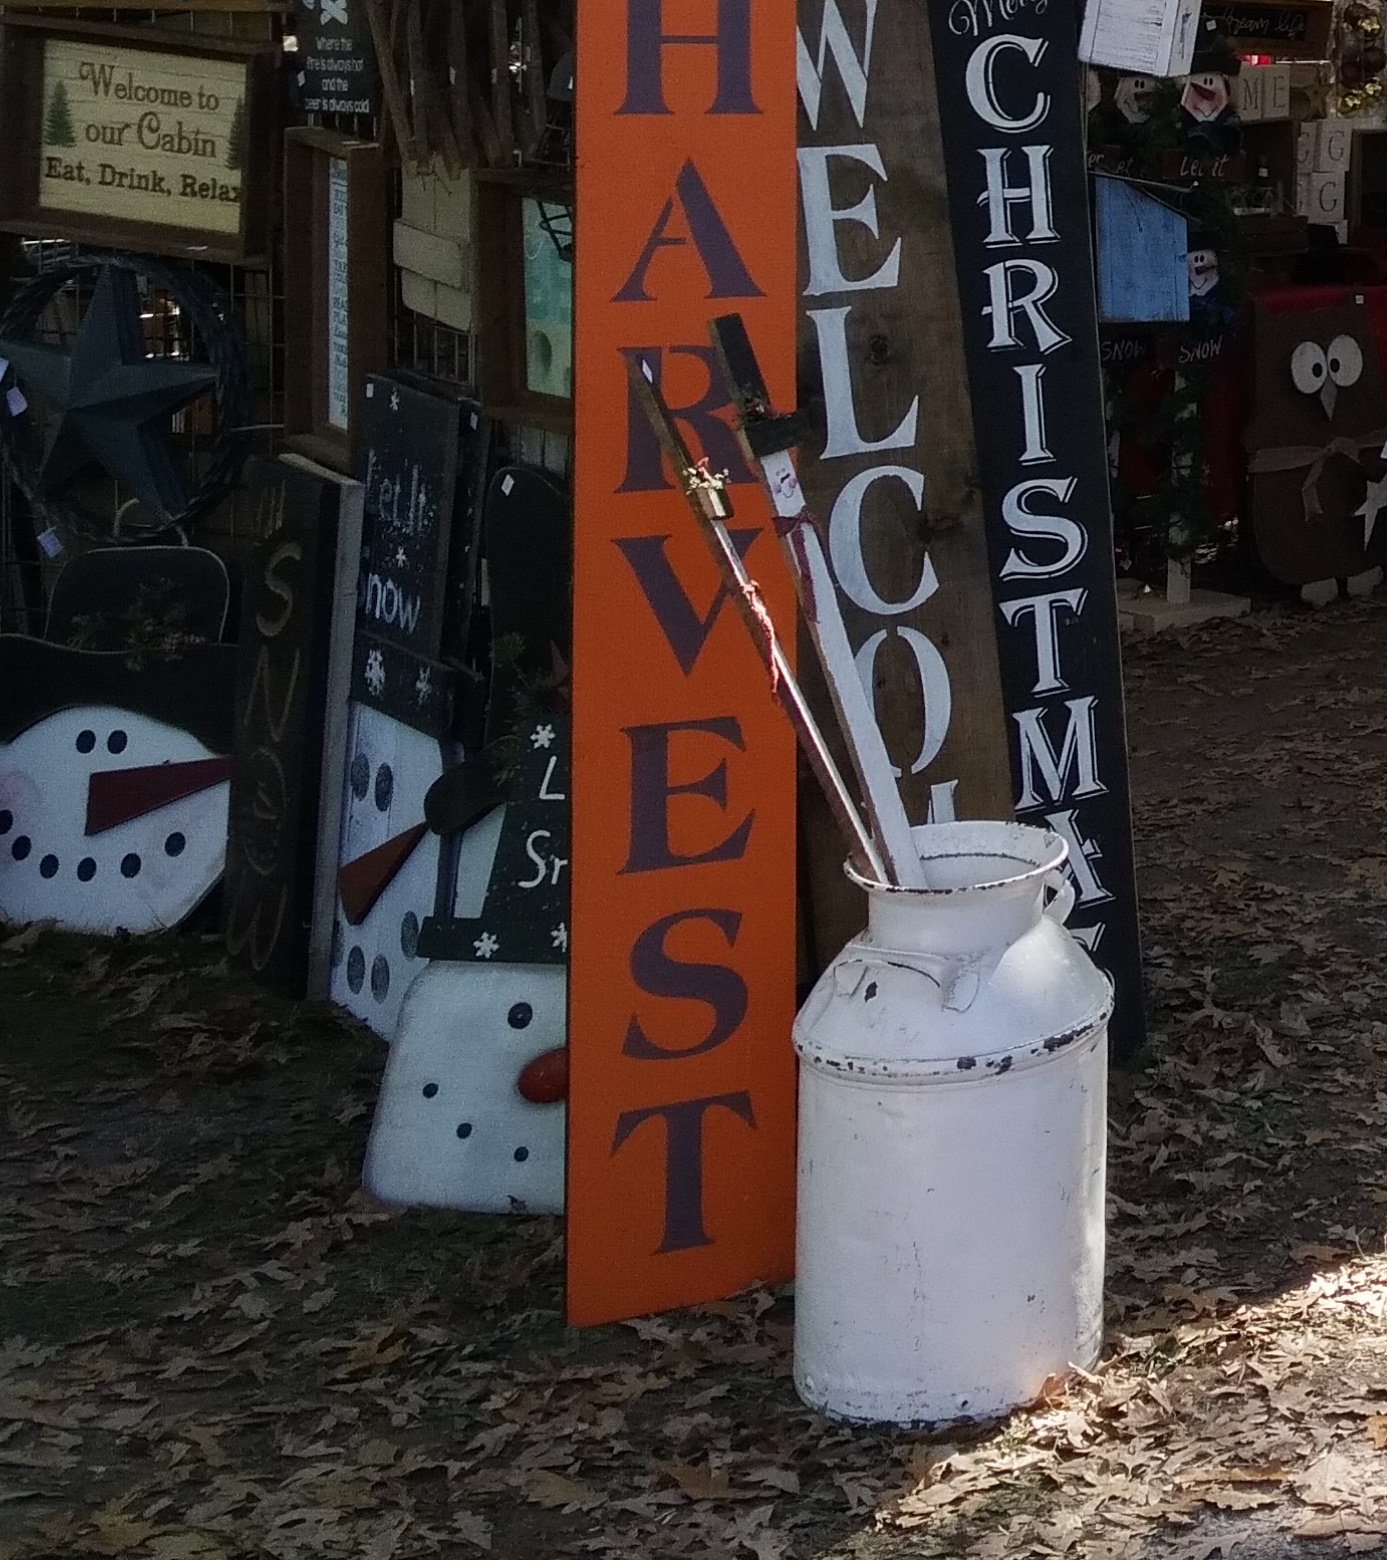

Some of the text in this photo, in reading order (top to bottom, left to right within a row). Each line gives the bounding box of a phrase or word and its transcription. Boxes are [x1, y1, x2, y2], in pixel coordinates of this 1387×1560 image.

[78, 61, 220, 111] Welcome to
[85, 111, 217, 158] our Cabin
[45, 156, 91, 185] Eat,
[98, 163, 172, 197] Drink,
[1178, 334, 1222, 364] SNOW
[360, 571, 422, 635] now
